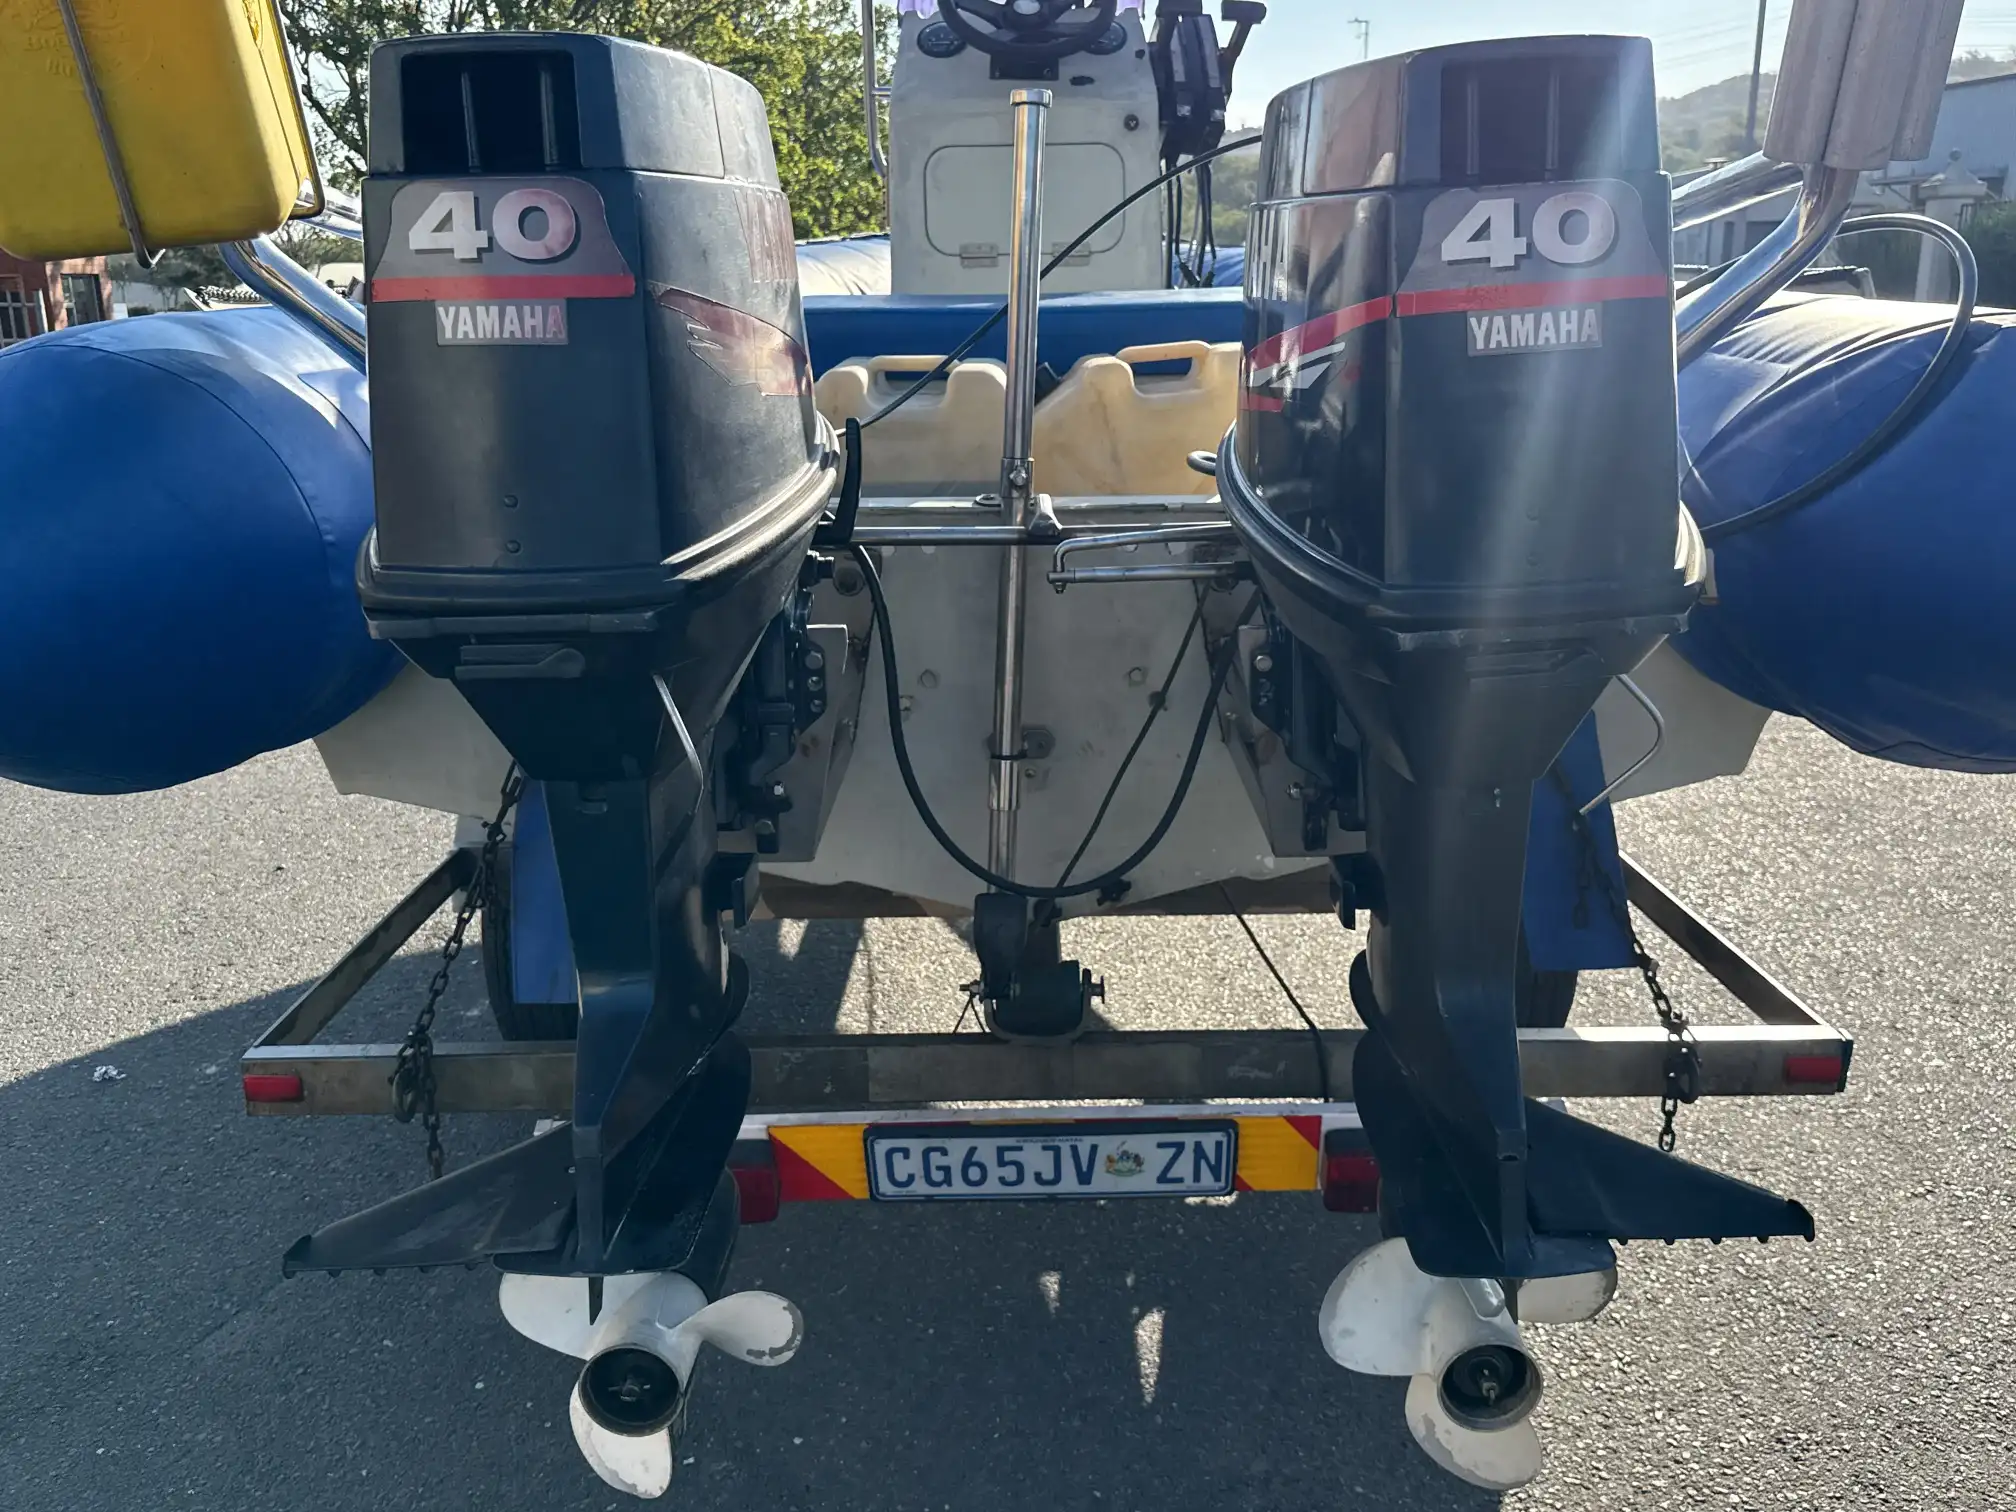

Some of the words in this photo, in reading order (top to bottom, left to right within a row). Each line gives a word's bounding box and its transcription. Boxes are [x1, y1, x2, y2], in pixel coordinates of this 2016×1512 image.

[408, 188, 578, 262] 40
[1440, 191, 1618, 268] 40
[437, 303, 566, 341] YAMAHA
[1469, 308, 1600, 350] YAMAHA
[884, 1143, 1099, 1188] CG65JV
[1155, 1140, 1223, 1185] ZN
